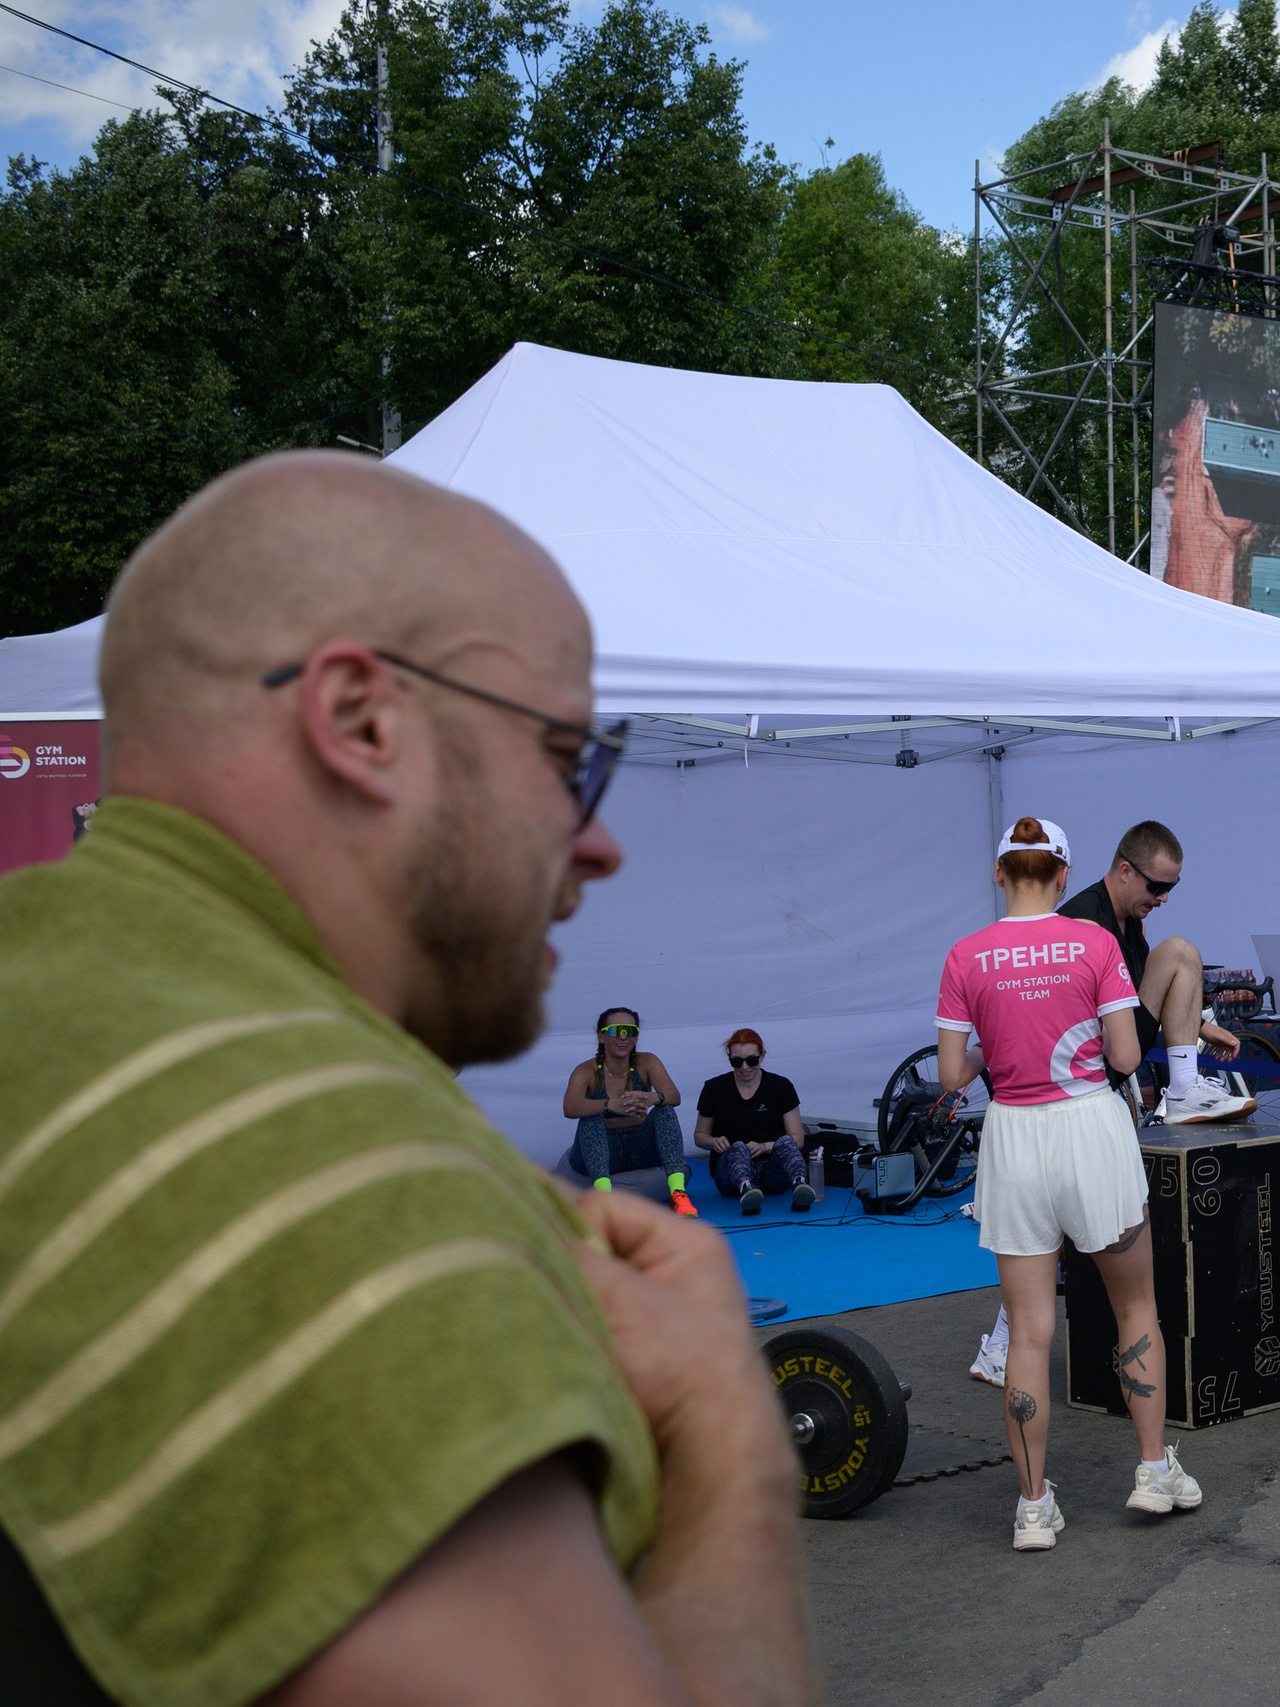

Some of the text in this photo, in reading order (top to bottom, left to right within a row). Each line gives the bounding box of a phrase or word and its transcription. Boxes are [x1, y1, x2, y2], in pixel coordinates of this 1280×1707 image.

[36, 746, 62, 755] GYM
[36, 756, 86, 766] STATION
[975, 942, 1086, 973] ТРЕНЕР
[996, 974, 1070, 991] GYM STATION
[1019, 989, 1050, 1001] TEAM
[1192, 1155, 1221, 1216] 60
[1257, 1172, 1273, 1331] YOUSTEEL
[770, 1356, 854, 1399] USTEEL
[1198, 1371, 1240, 1417] 75
[854, 1410, 872, 1427] 15
[797, 1436, 870, 1493] YOUSTE
